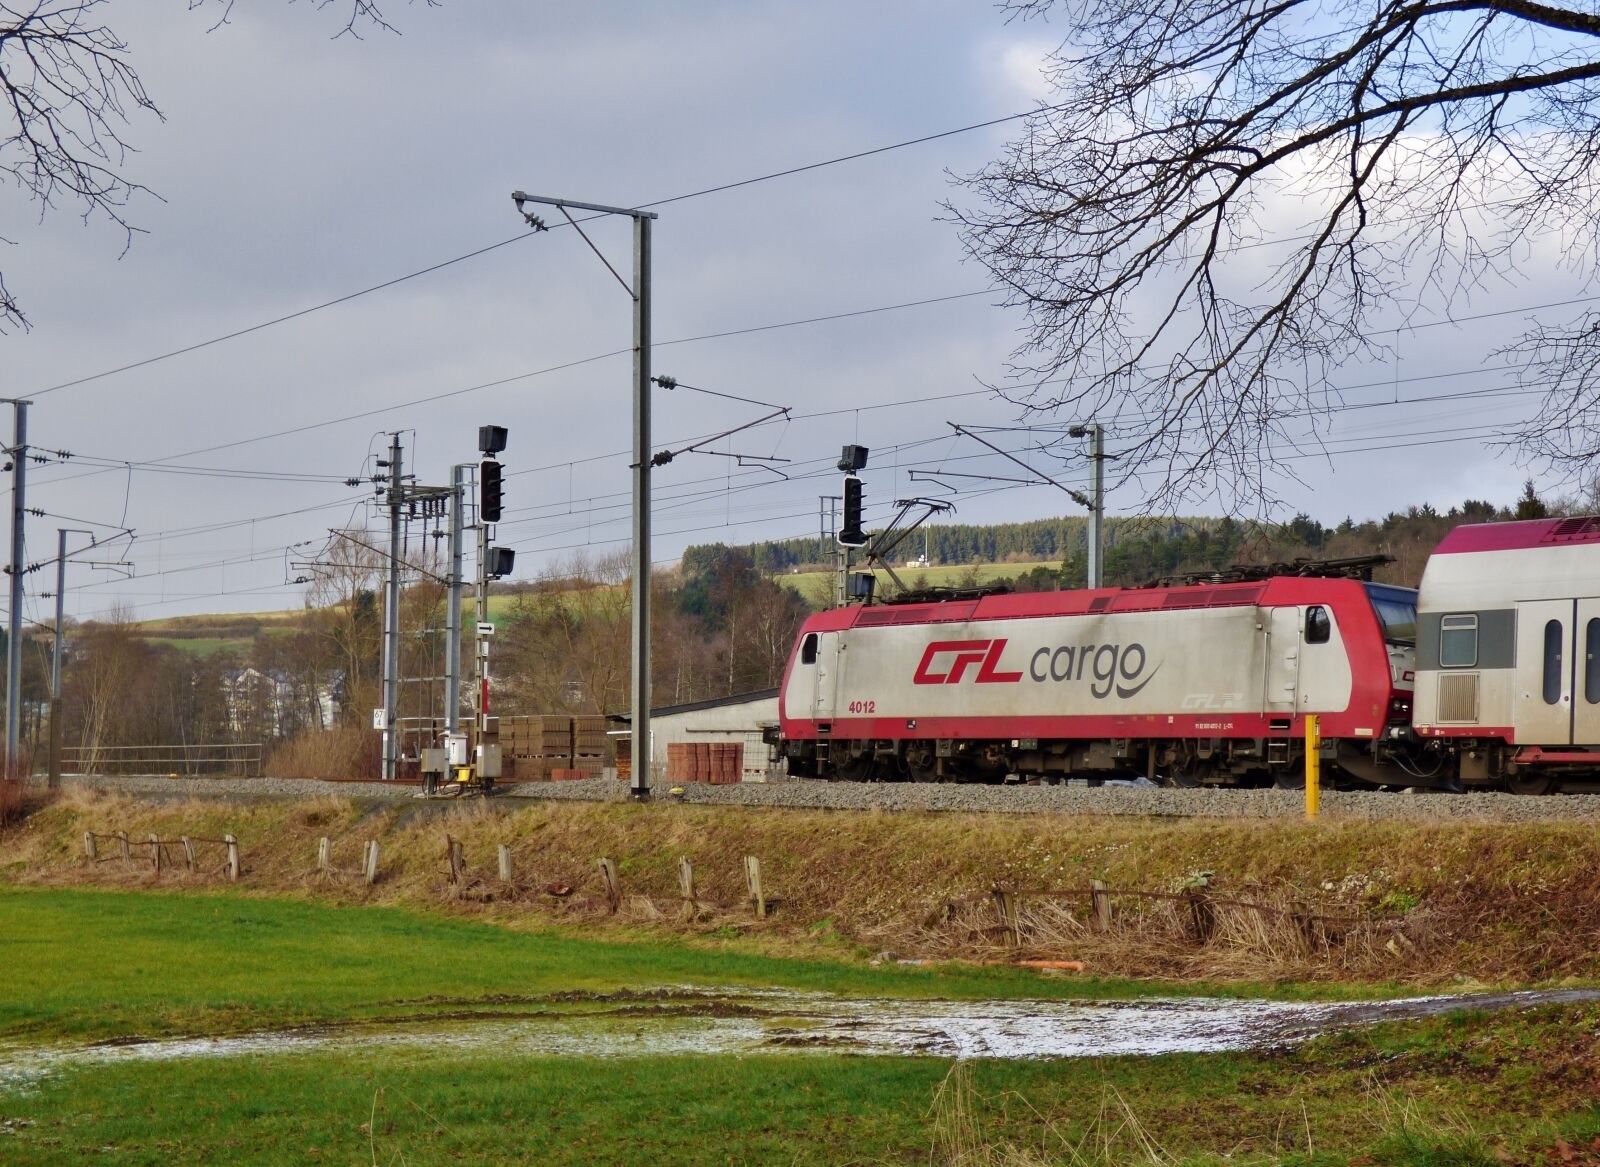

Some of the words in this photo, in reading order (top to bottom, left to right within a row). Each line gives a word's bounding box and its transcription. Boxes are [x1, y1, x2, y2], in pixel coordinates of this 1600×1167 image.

[914, 639, 1023, 684] CFL
[1029, 643, 1146, 699] cargo
[849, 701, 875, 713] 4012
[375, 710, 383, 718] 67
